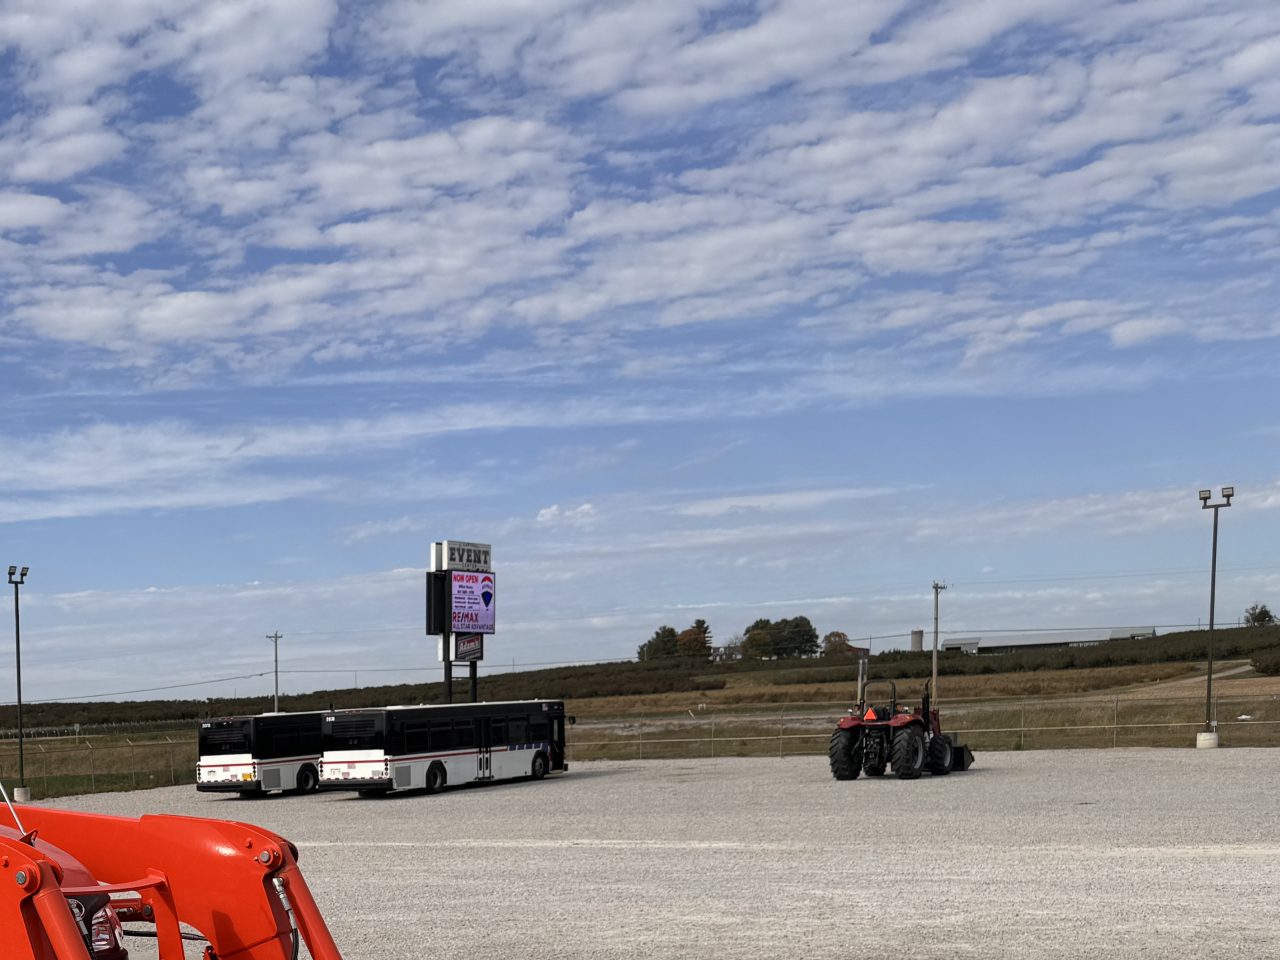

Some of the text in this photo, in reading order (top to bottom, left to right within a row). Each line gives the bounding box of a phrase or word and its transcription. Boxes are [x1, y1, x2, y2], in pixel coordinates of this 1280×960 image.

[449, 546, 490, 565] EVENT
[453, 574, 479, 584] NOW OPEN
[452, 611, 479, 623] RE/MAX
